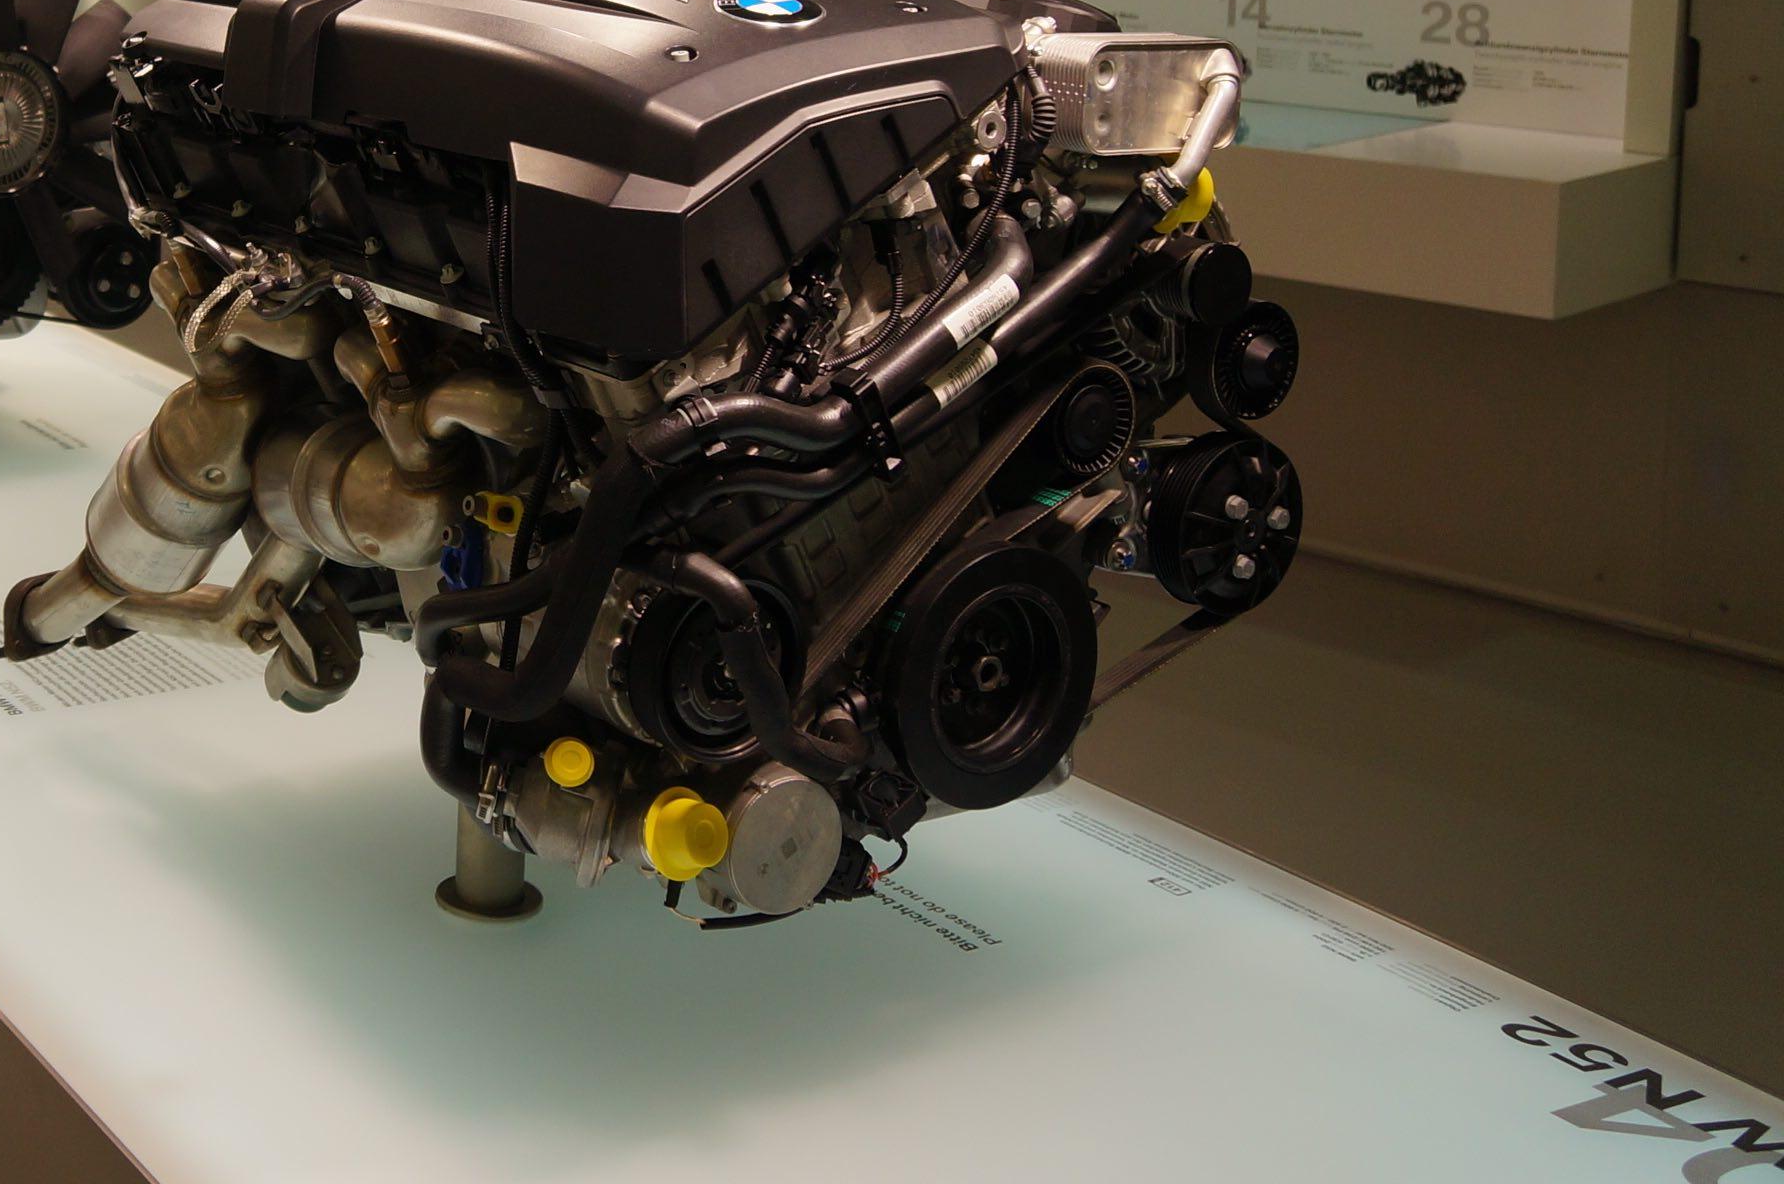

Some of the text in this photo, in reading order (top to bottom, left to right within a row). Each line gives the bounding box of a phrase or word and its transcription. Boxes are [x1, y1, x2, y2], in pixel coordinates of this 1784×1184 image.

[1420, 0, 1490, 47] 28
[893, 884, 924, 902] not
[893, 903, 937, 930] nicht
[922, 900, 946, 915] do
[935, 926, 979, 953] Bitte
[944, 913, 1003, 947] Please
